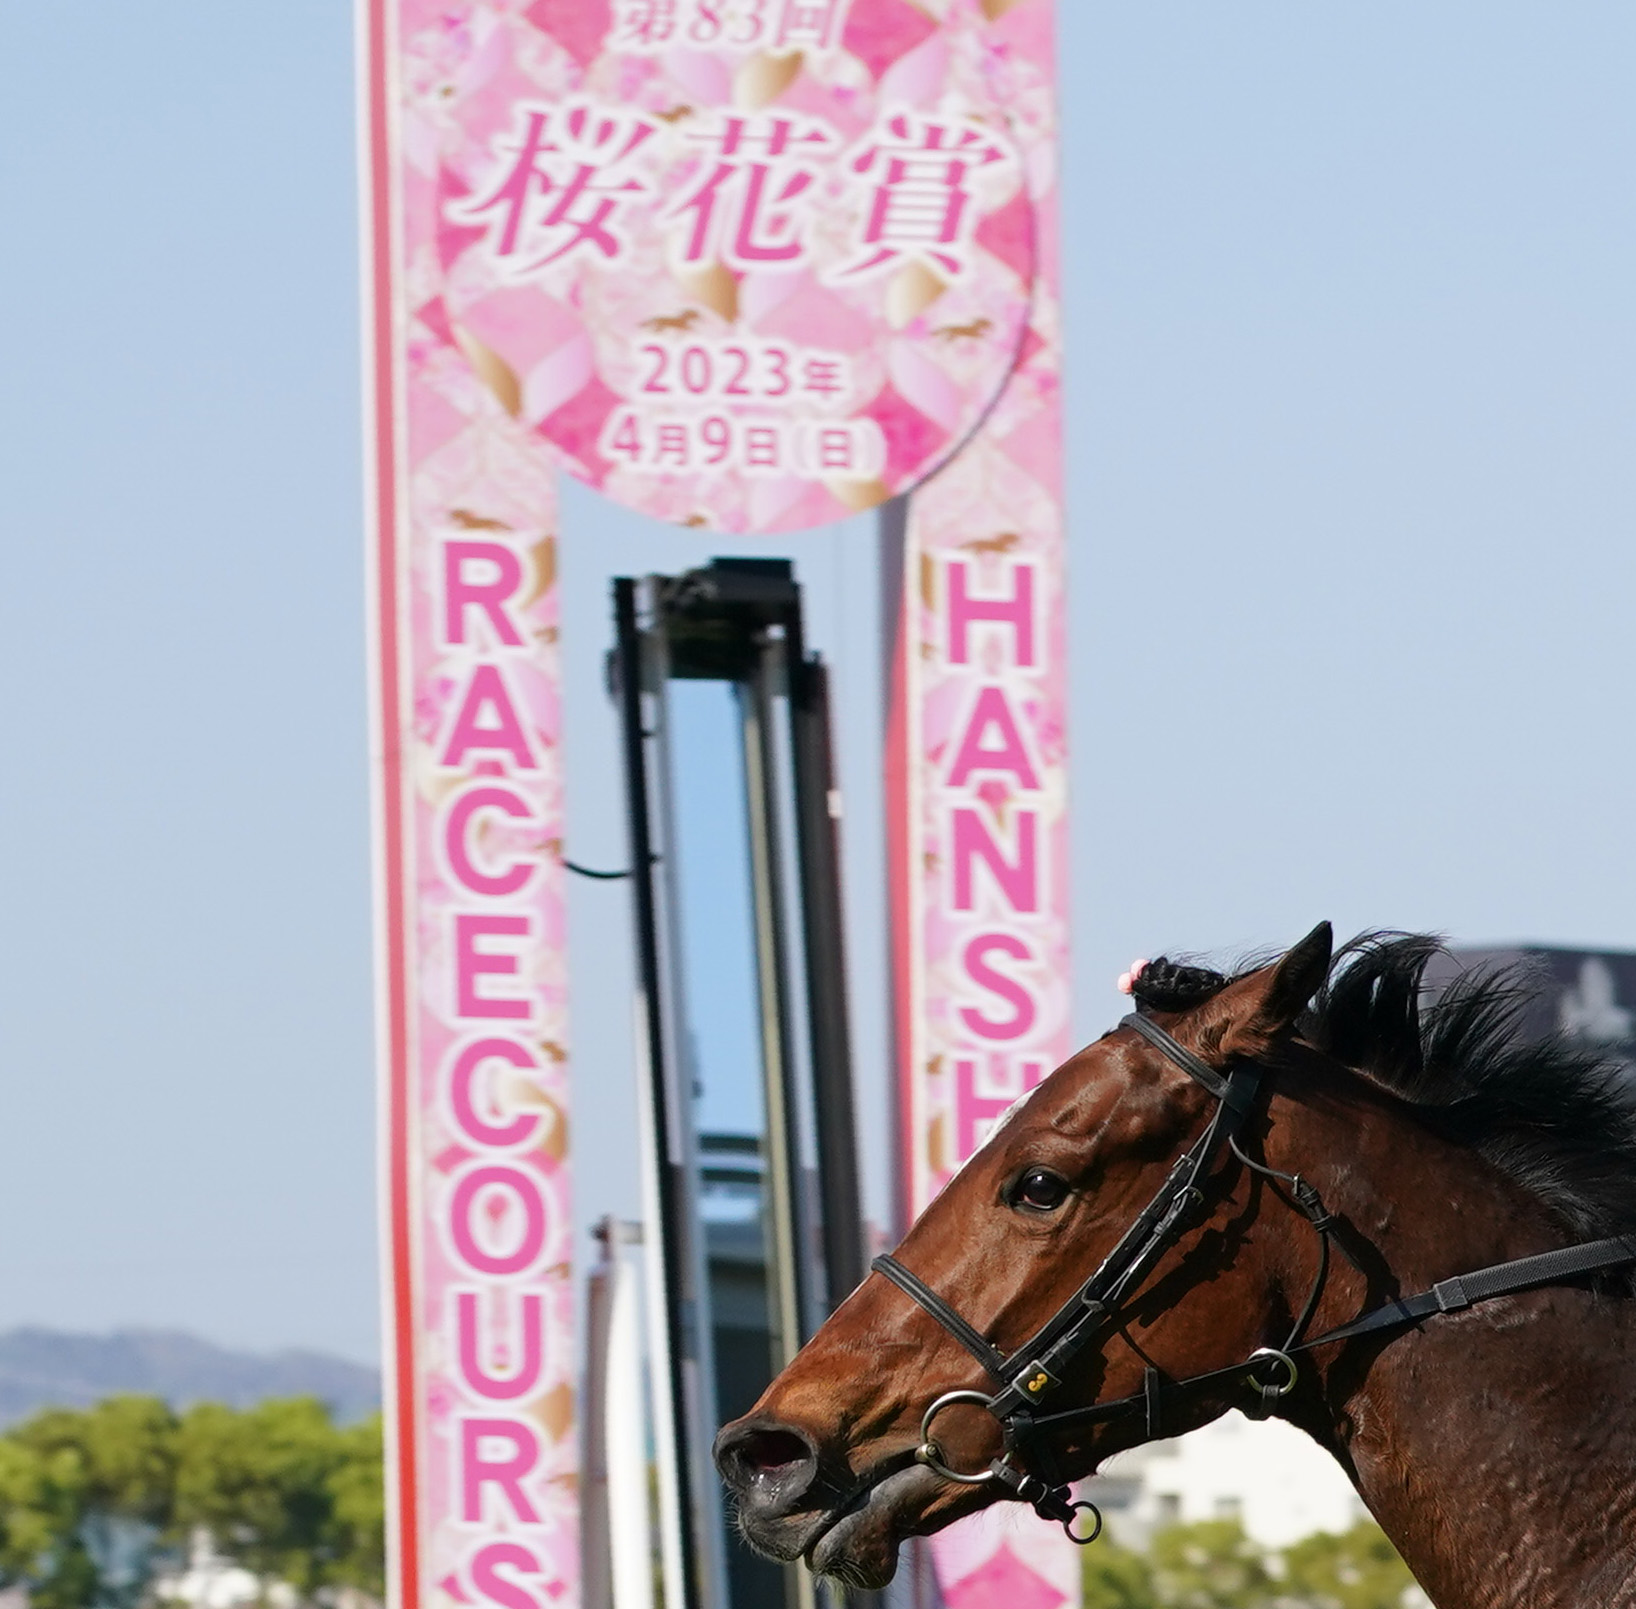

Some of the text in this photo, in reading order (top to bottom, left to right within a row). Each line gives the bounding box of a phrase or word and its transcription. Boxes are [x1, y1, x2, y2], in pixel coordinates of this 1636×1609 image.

[464, 107, 1008, 277] 桜花賞
[642, 344, 843, 400] 2023年
[1027, 1372, 1048, 1392] 3
